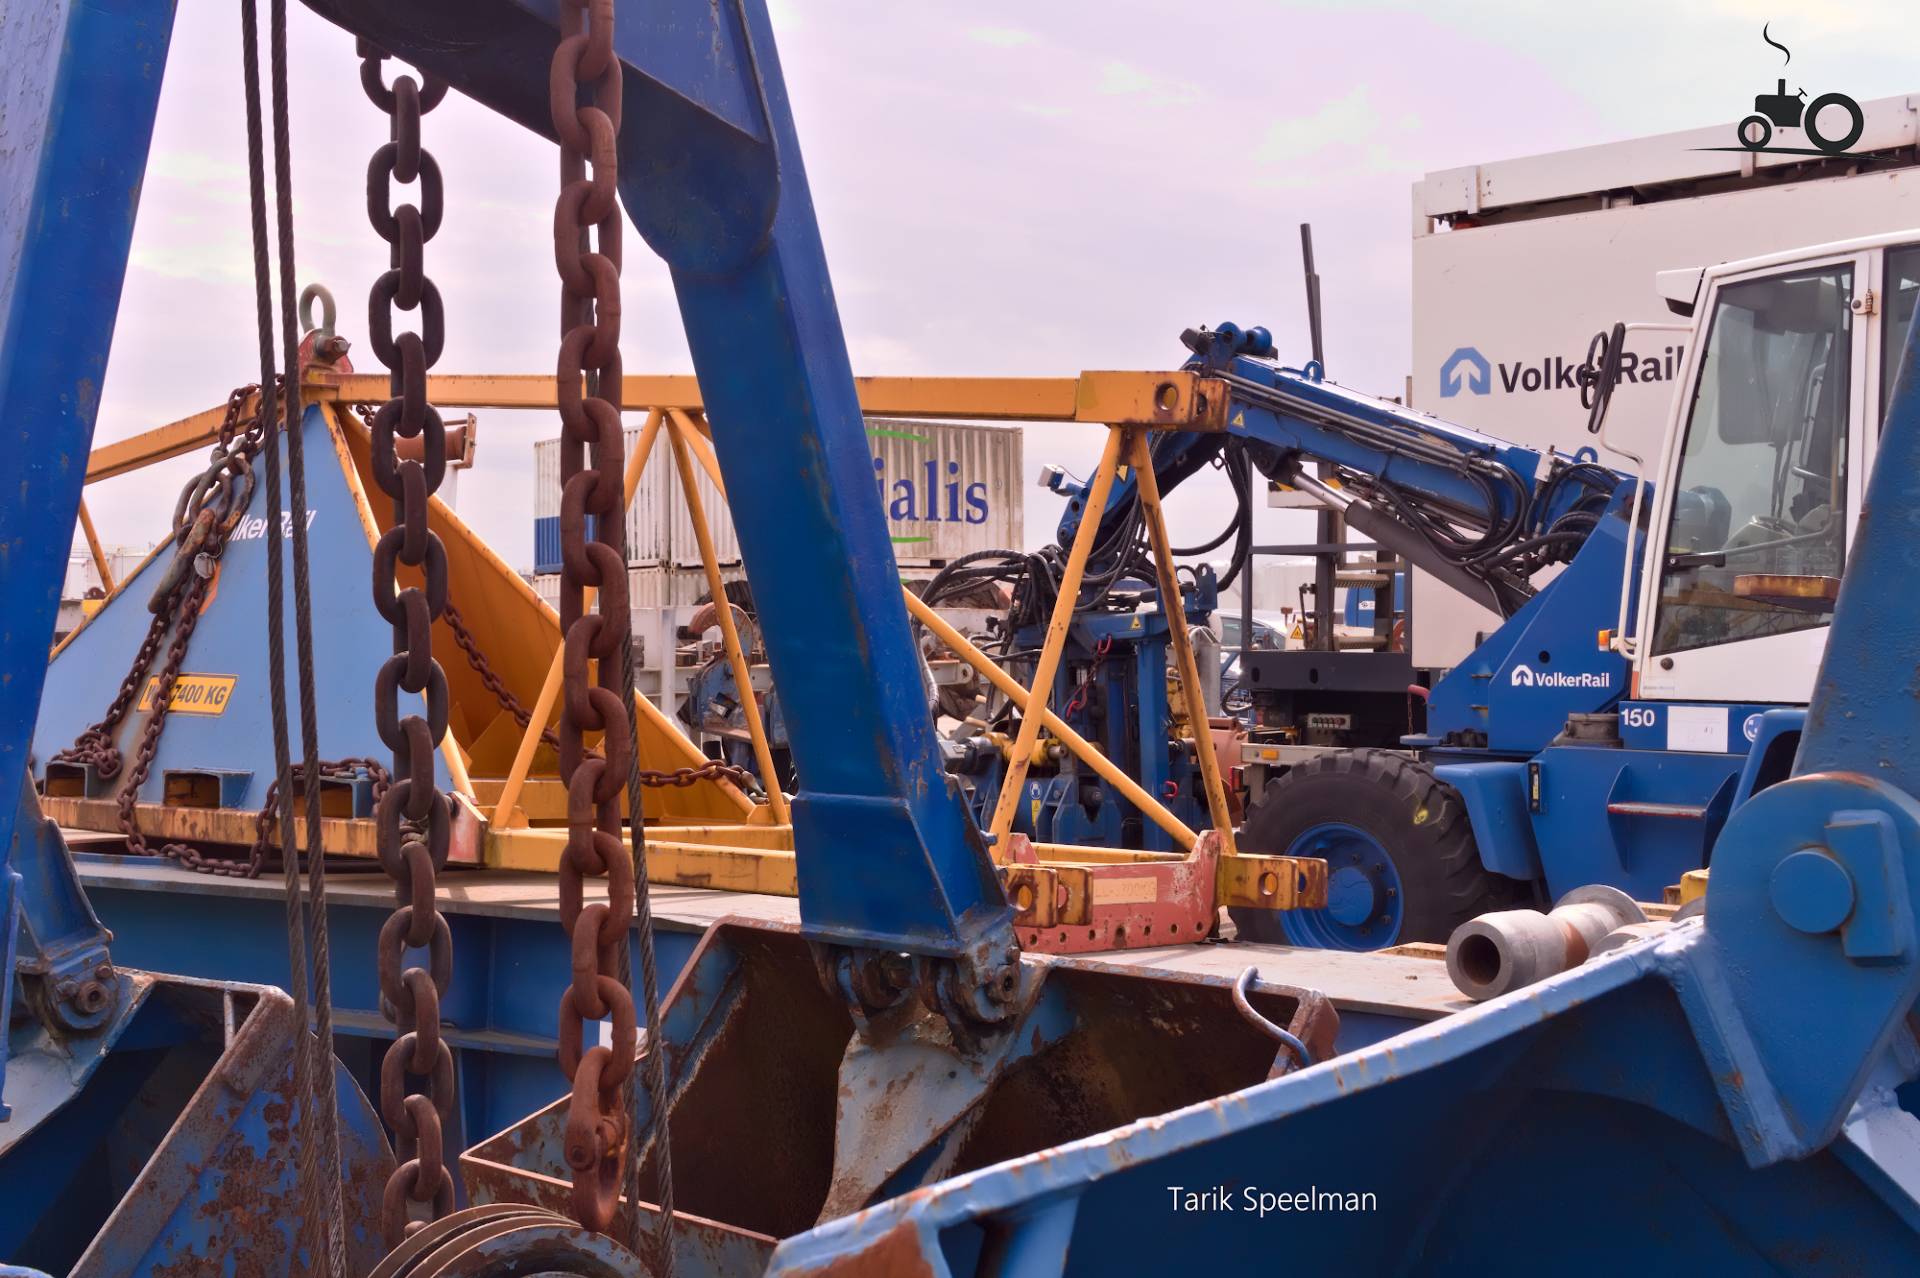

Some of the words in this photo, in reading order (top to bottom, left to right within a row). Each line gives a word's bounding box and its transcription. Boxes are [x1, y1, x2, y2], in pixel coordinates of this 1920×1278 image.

[1498, 345, 1685, 393] VolkeRail
[873, 457, 989, 524] ialis
[1535, 672, 1610, 688] VolkerRail
[203, 685, 227, 705] KG
[1620, 708, 1655, 727] 150
